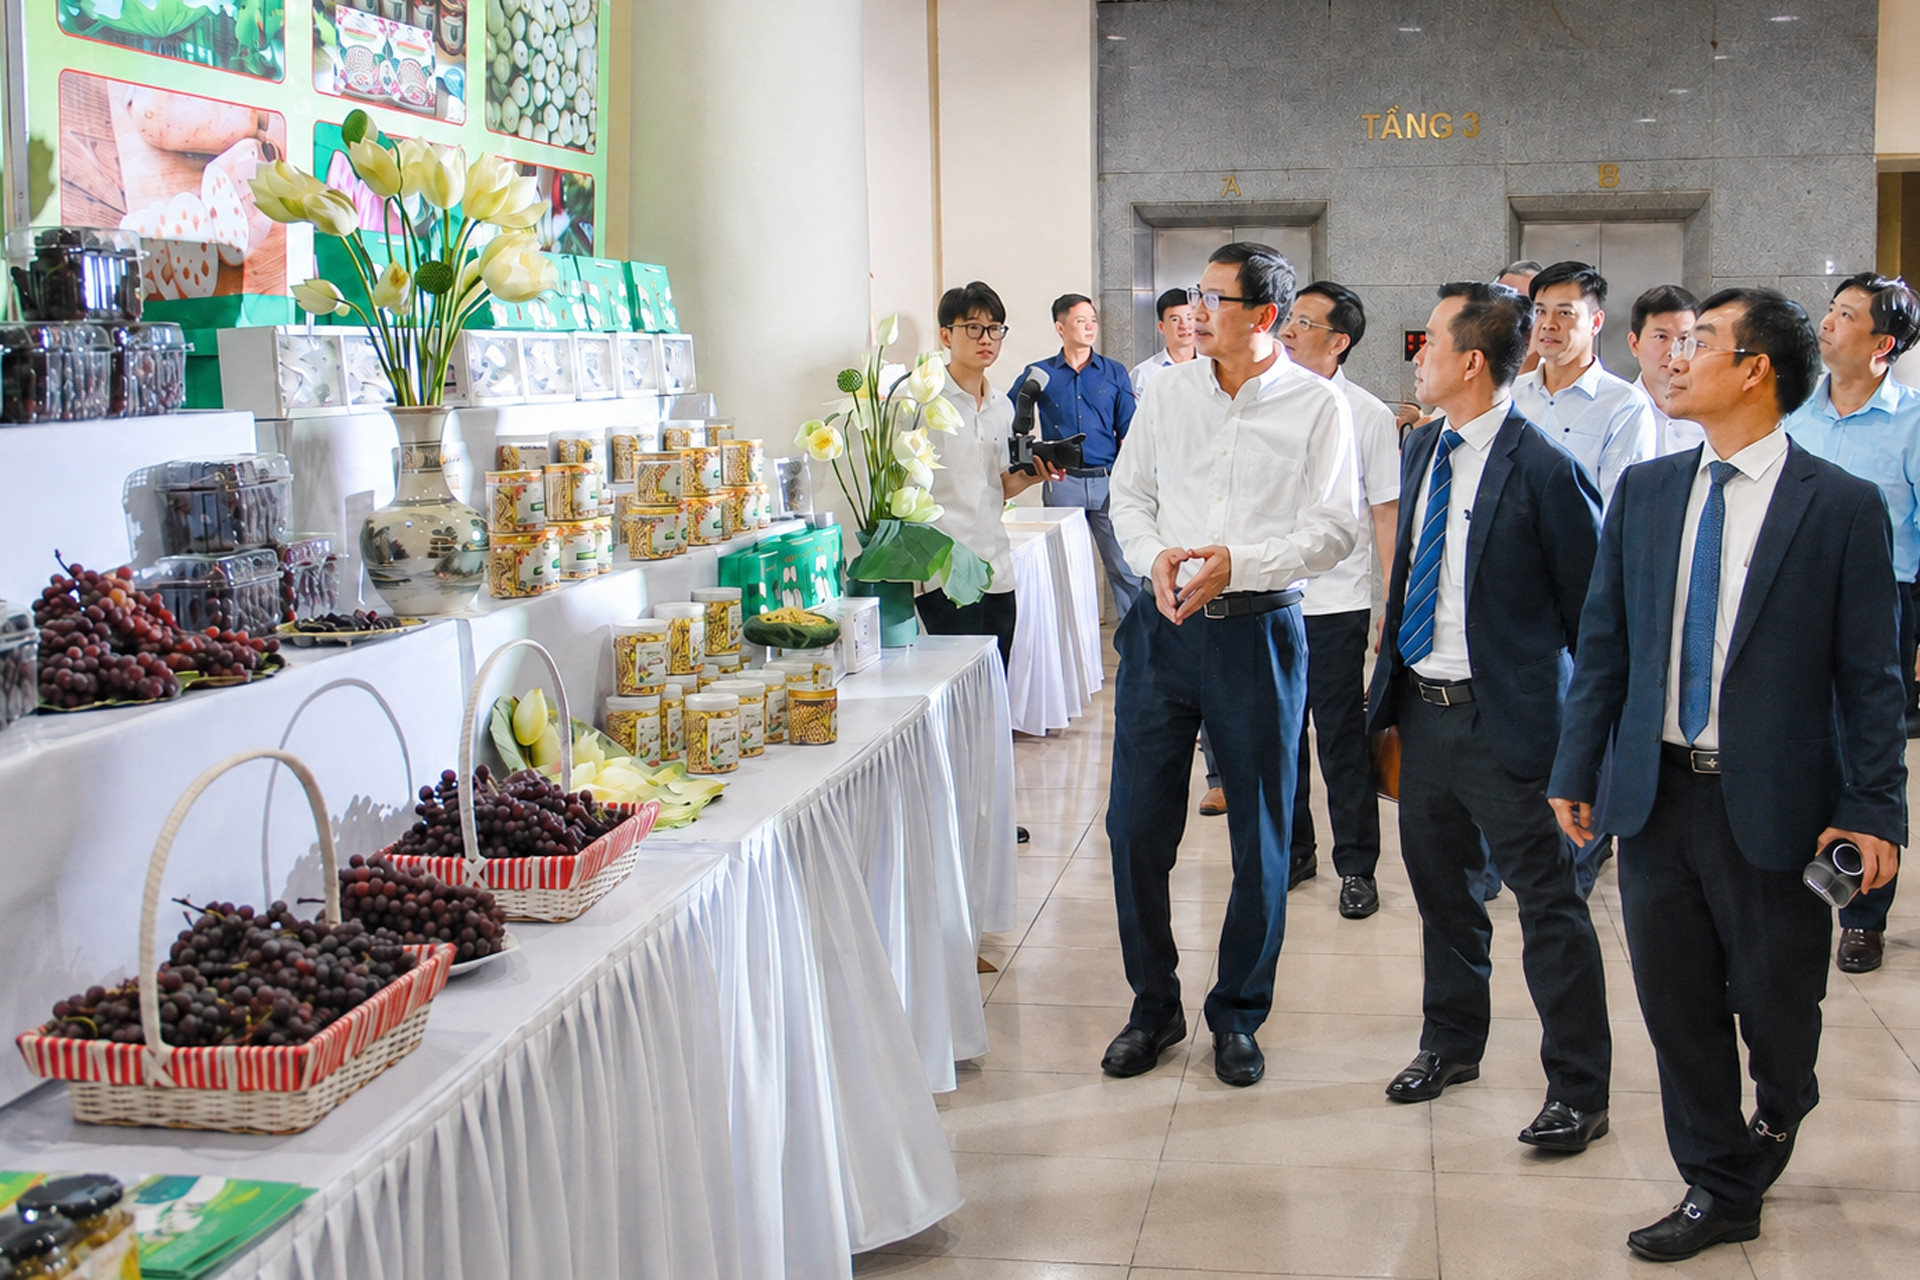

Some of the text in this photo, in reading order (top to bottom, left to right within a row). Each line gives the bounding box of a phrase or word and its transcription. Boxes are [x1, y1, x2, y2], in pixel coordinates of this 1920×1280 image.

[1360, 104, 1481, 140] TẦNG 3
[1221, 173, 1242, 198] A
[1597, 162, 1620, 188] B
